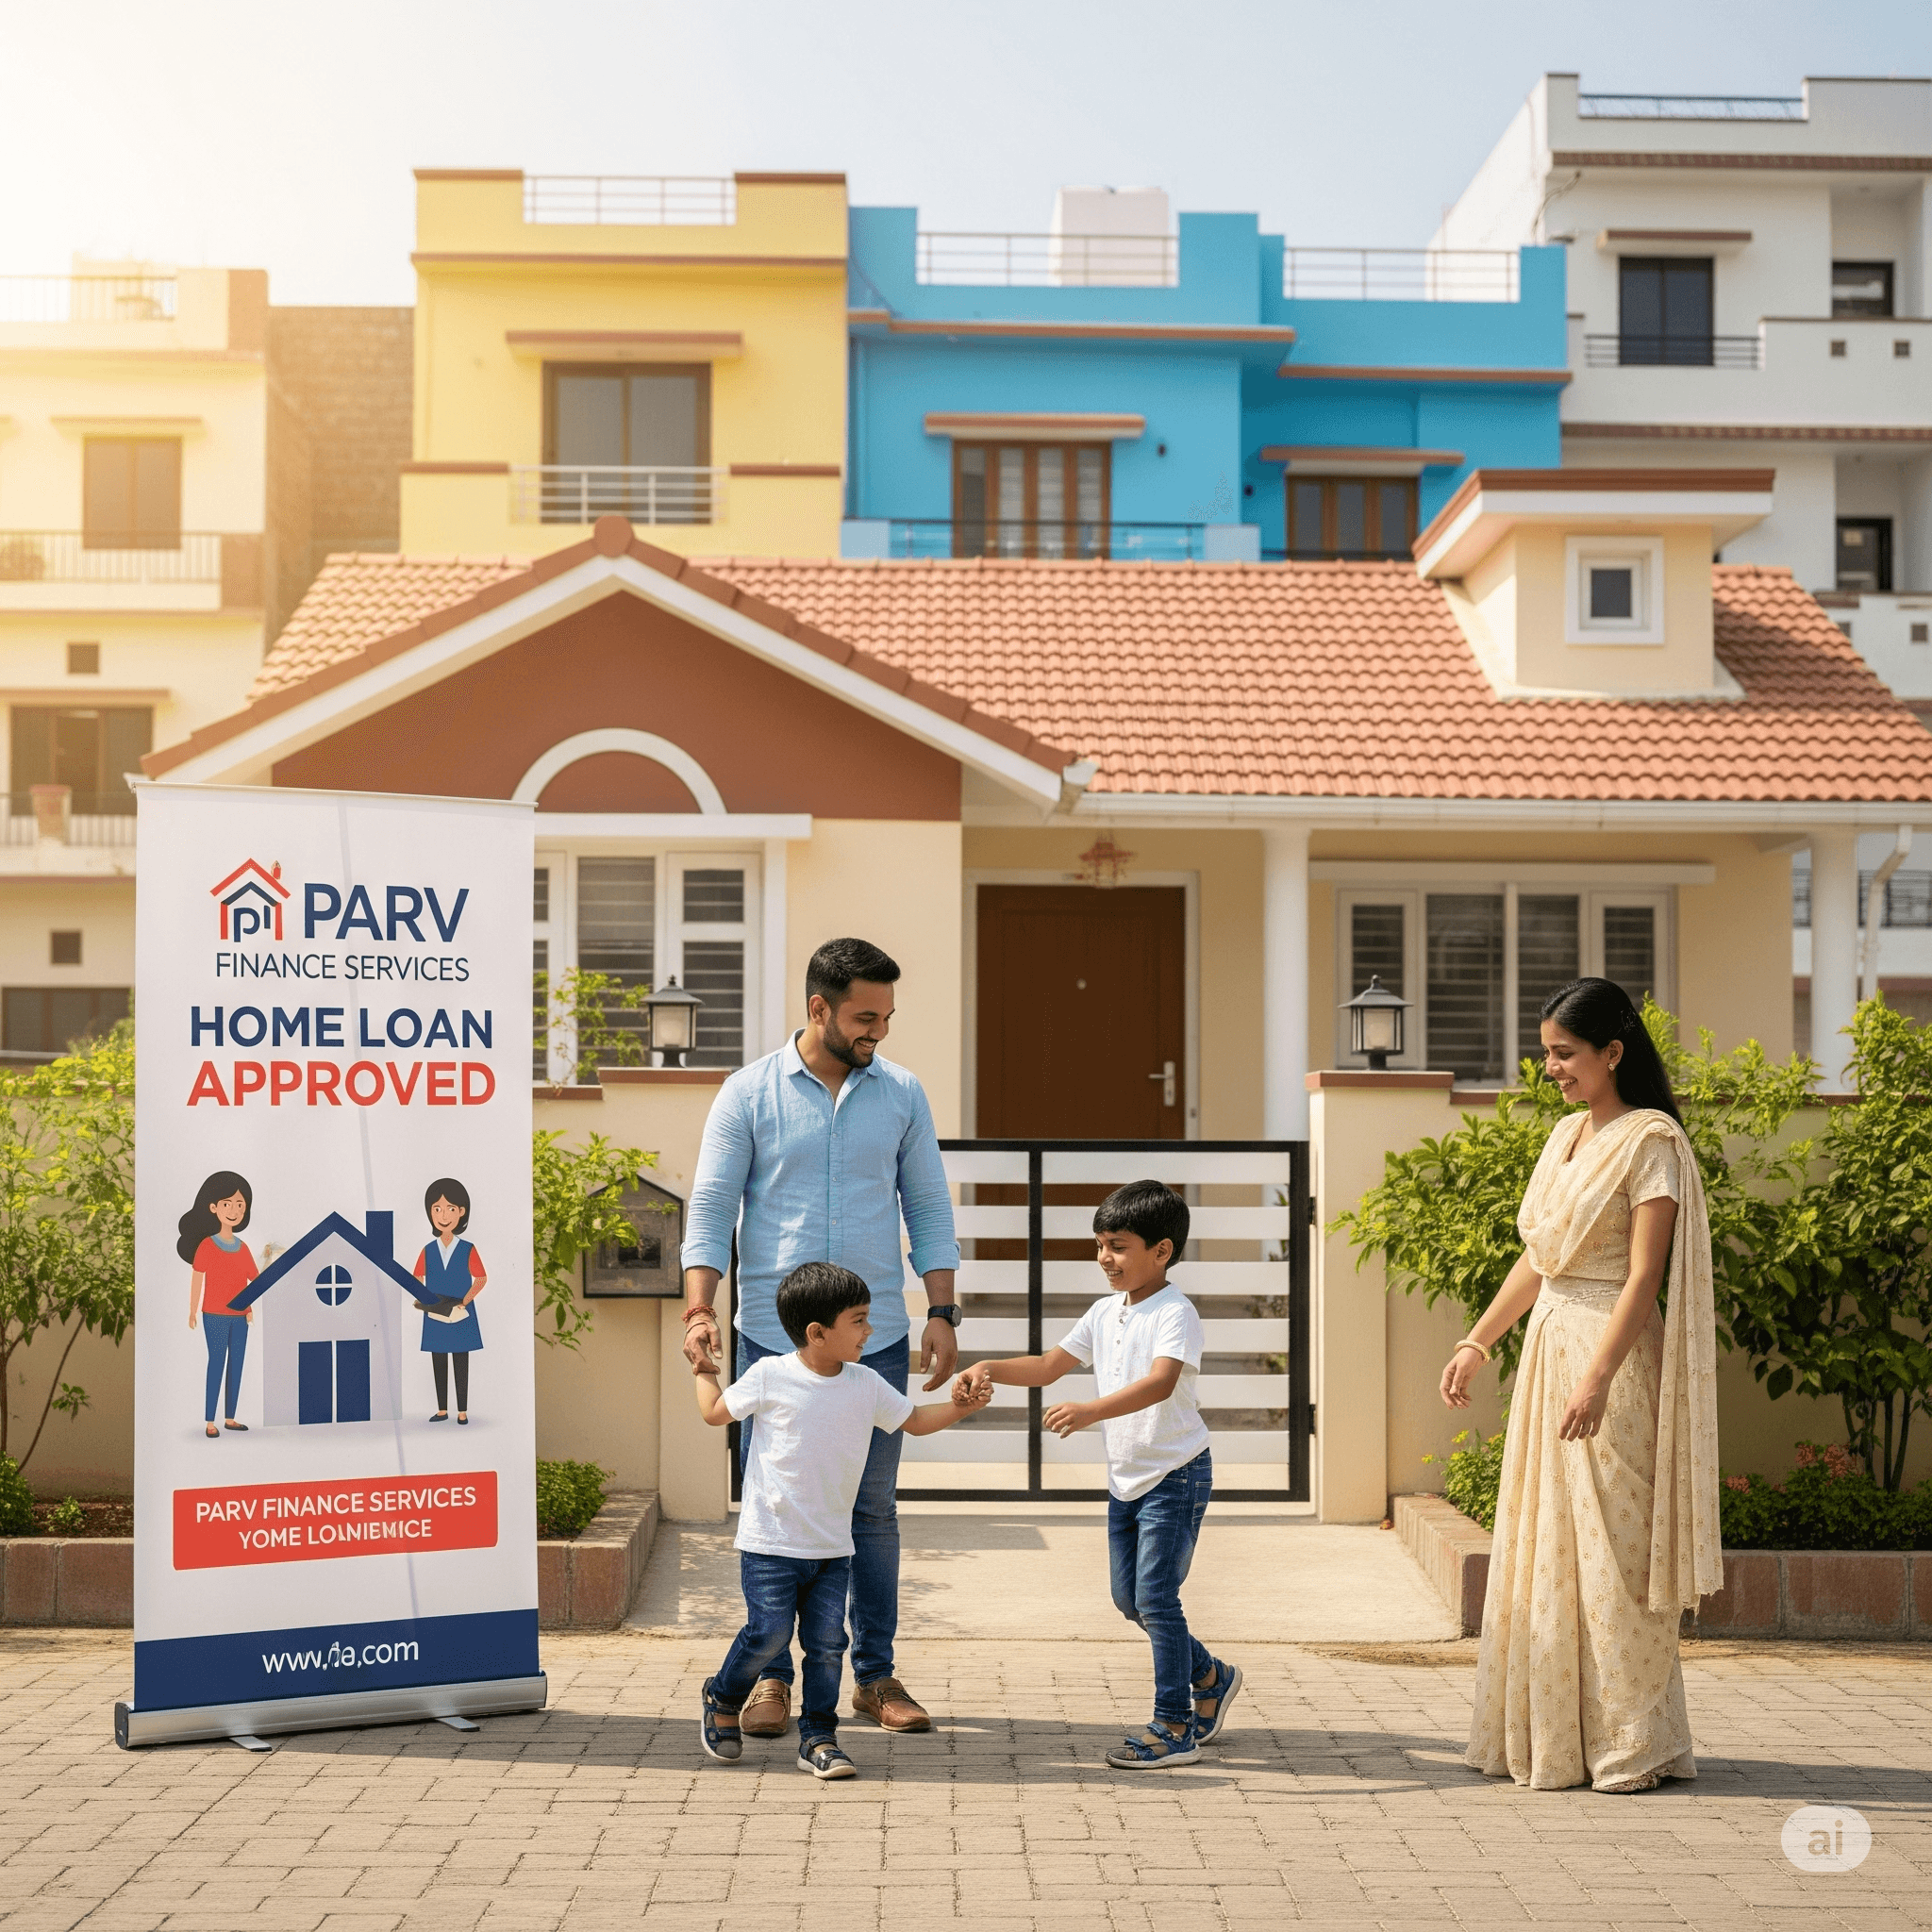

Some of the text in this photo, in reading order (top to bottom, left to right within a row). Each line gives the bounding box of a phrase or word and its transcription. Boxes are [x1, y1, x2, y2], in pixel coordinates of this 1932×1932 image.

[304, 883, 470, 942] PARV
[216, 952, 470, 982] FINANCE SERVICES
[191, 1006, 492, 1048] HOME LOAN
[186, 1060, 496, 1107] APPROVED
[196, 1487, 476, 1524] PARV FINANCE SERVICES
[239, 1526, 302, 1550] YOME
